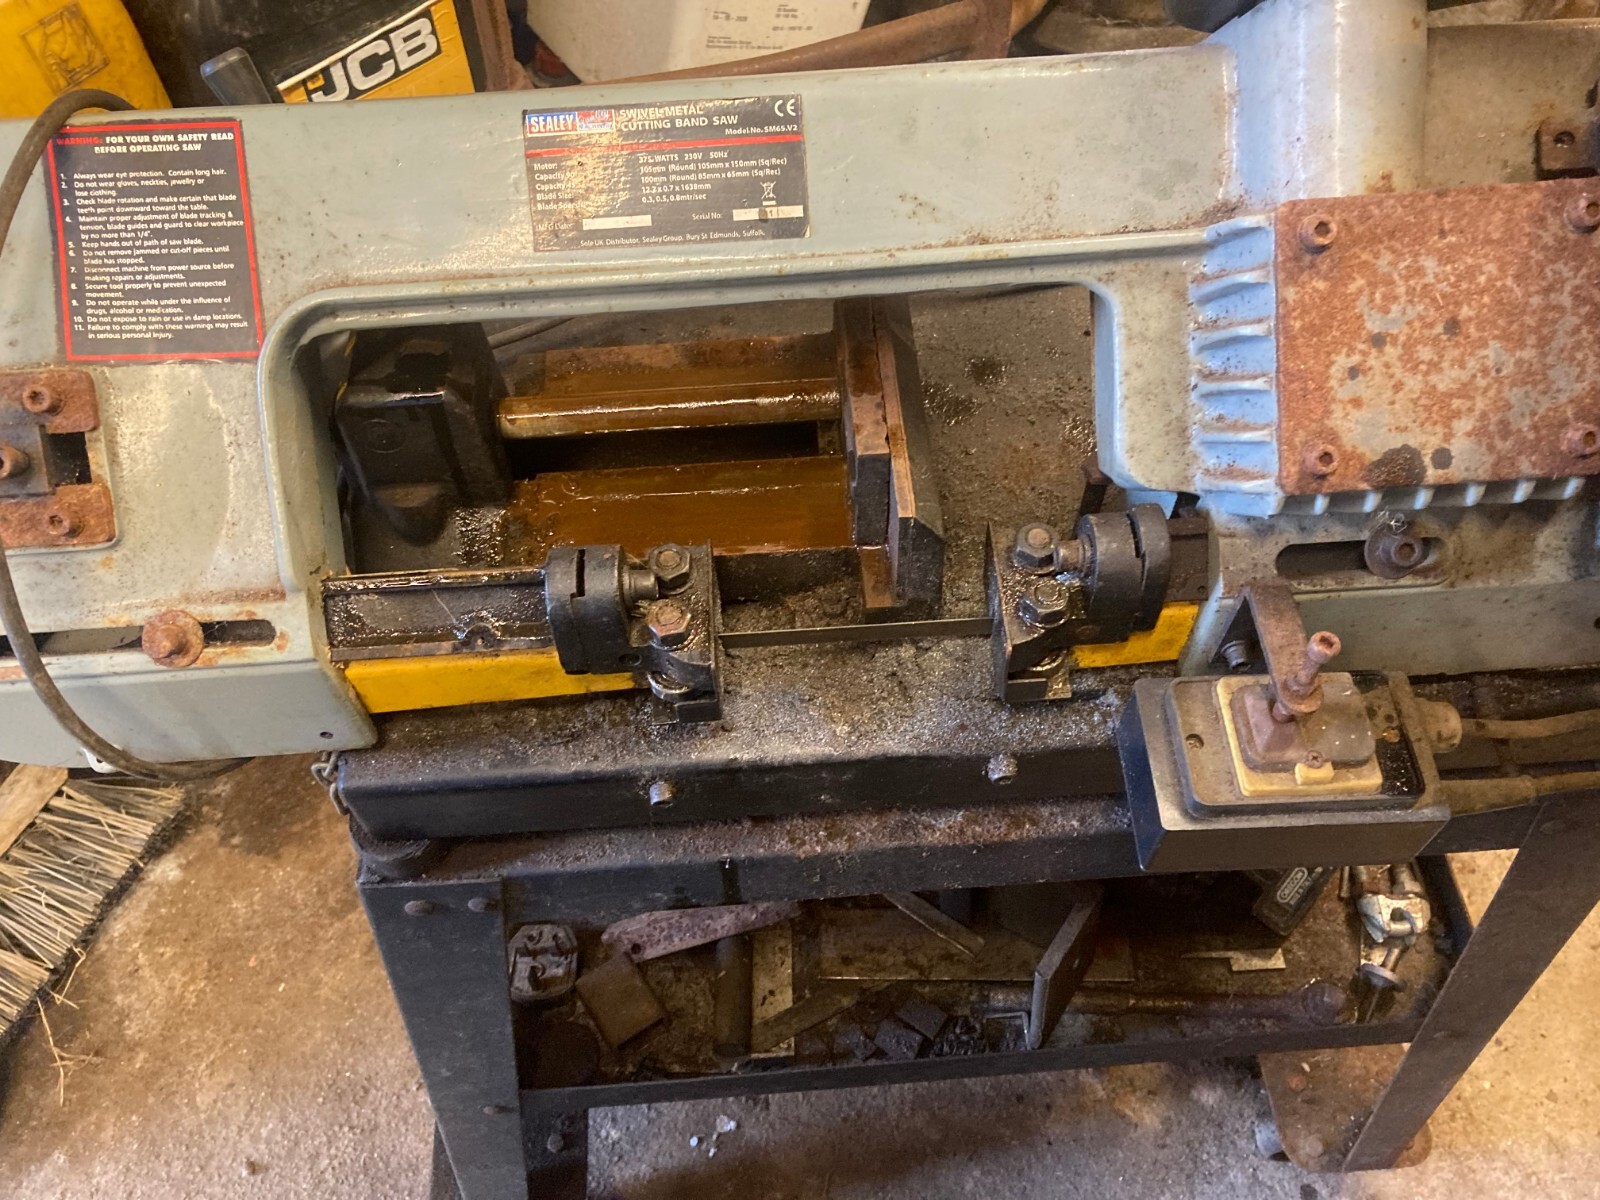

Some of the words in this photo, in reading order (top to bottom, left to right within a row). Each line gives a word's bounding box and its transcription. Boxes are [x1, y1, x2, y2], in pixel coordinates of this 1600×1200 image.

[311, 17, 438, 102] JCB
[530, 114, 573, 132] SEALEY
[1281, 870, 1303, 898] OREGON
